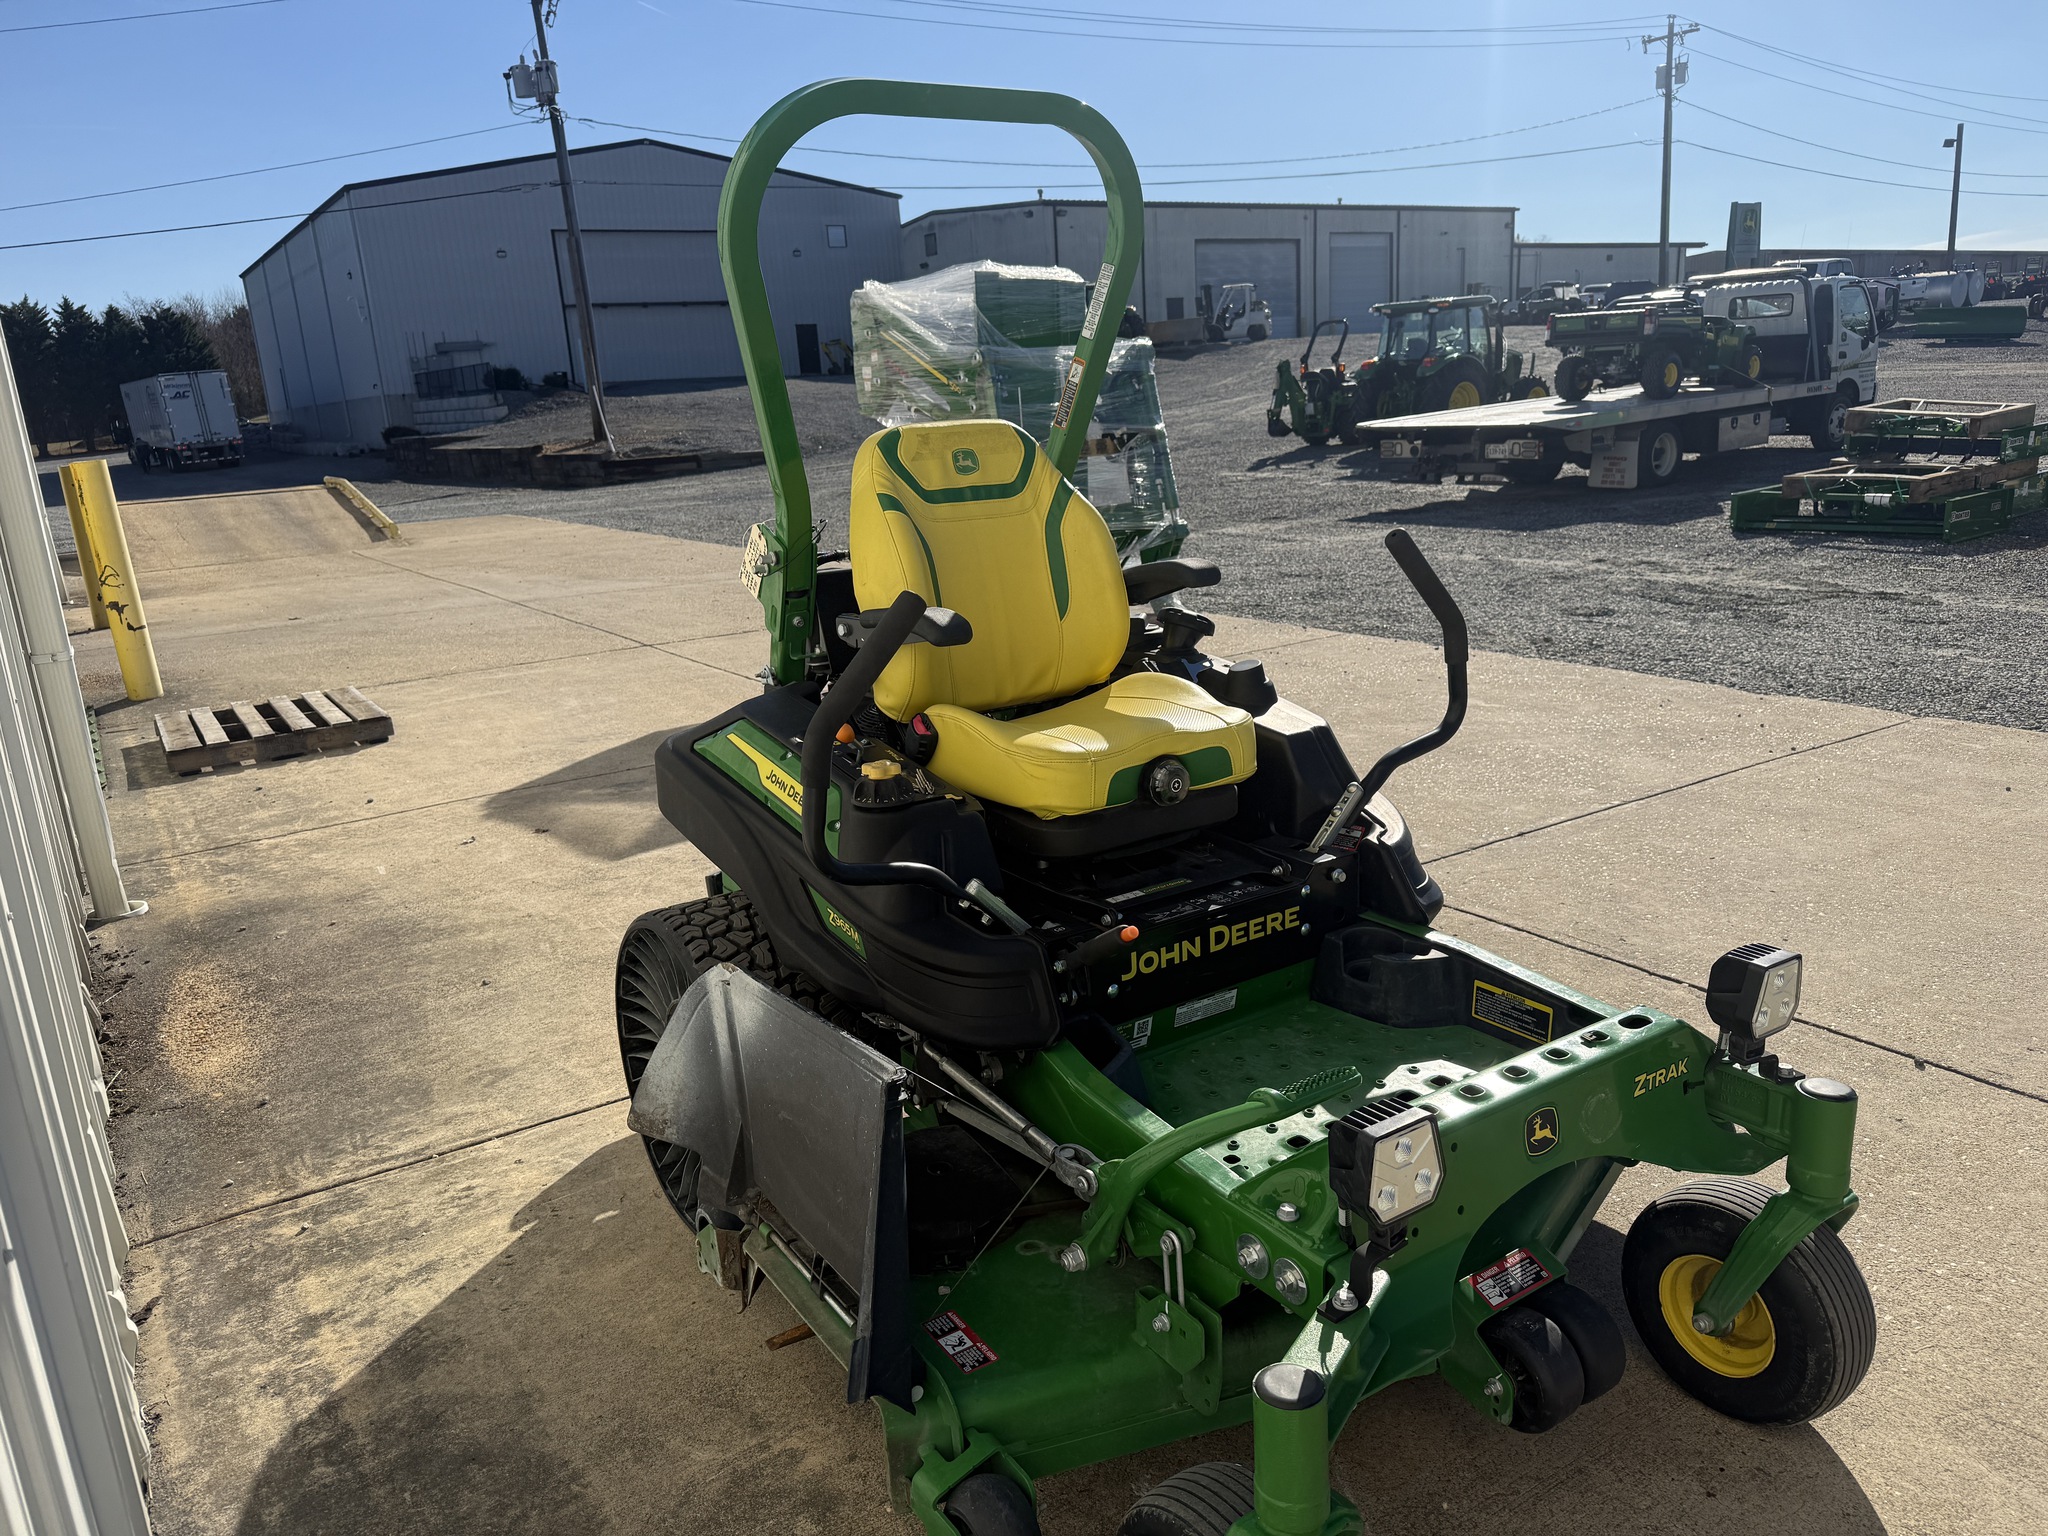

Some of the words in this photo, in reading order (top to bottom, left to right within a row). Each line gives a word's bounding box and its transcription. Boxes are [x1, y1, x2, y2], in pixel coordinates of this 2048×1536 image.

[765, 769, 789, 794] JOHN
[787, 784, 803, 807] DEE
[826, 906, 860, 944] Z965M
[1121, 935, 1201, 982] JOHN
[1209, 905, 1300, 953] DEERE
[1633, 1057, 1689, 1098] ZTRAK
[1480, 1266, 1500, 1278] DANGER
[1506, 1251, 1527, 1265] PELIGRO
[980, 1344, 998, 1361] PELIGRO
